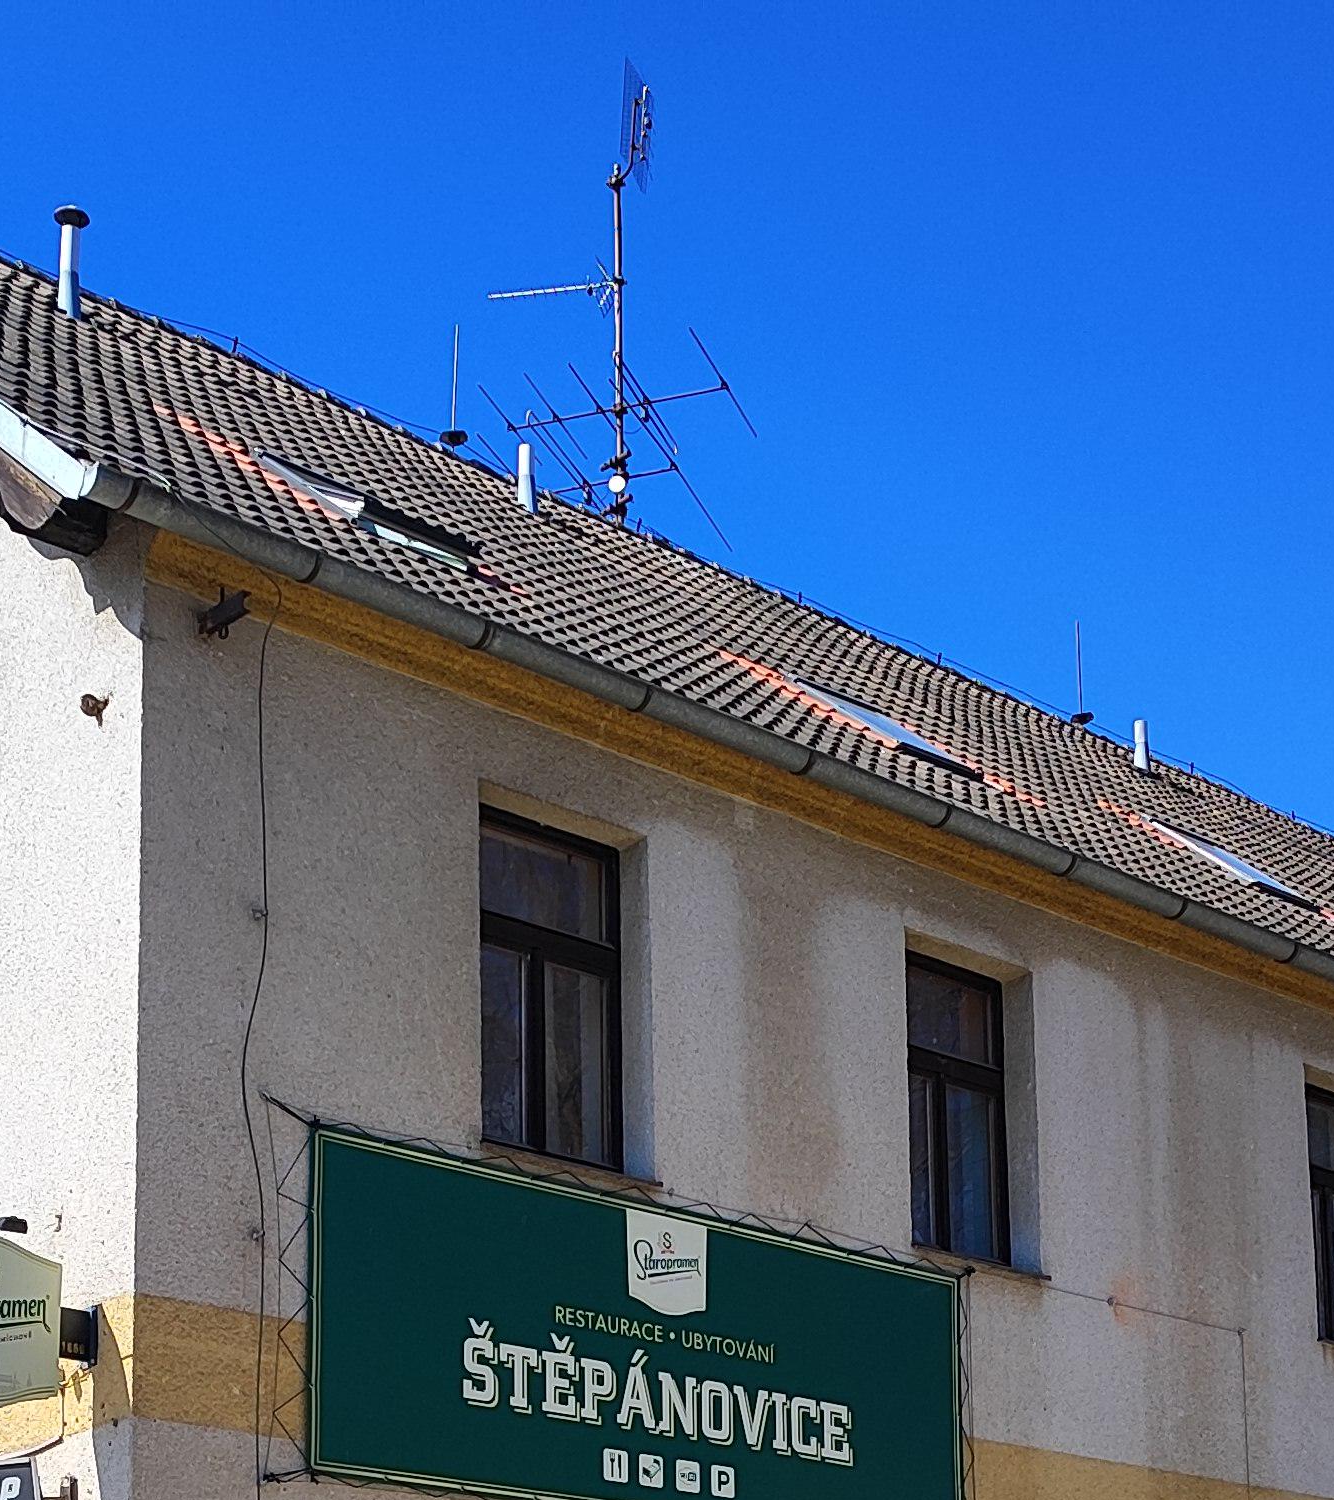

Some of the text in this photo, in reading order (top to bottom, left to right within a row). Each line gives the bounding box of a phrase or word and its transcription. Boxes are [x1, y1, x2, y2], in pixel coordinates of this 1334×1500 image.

[633, 1239, 702, 1280] Staropramen
[555, 1305, 775, 1364] RESTAURACE UBYTOVÁNÍ
[462, 1317, 854, 1467] ŠTĚPÁNOVICE
[717, 1470, 730, 1492] P
